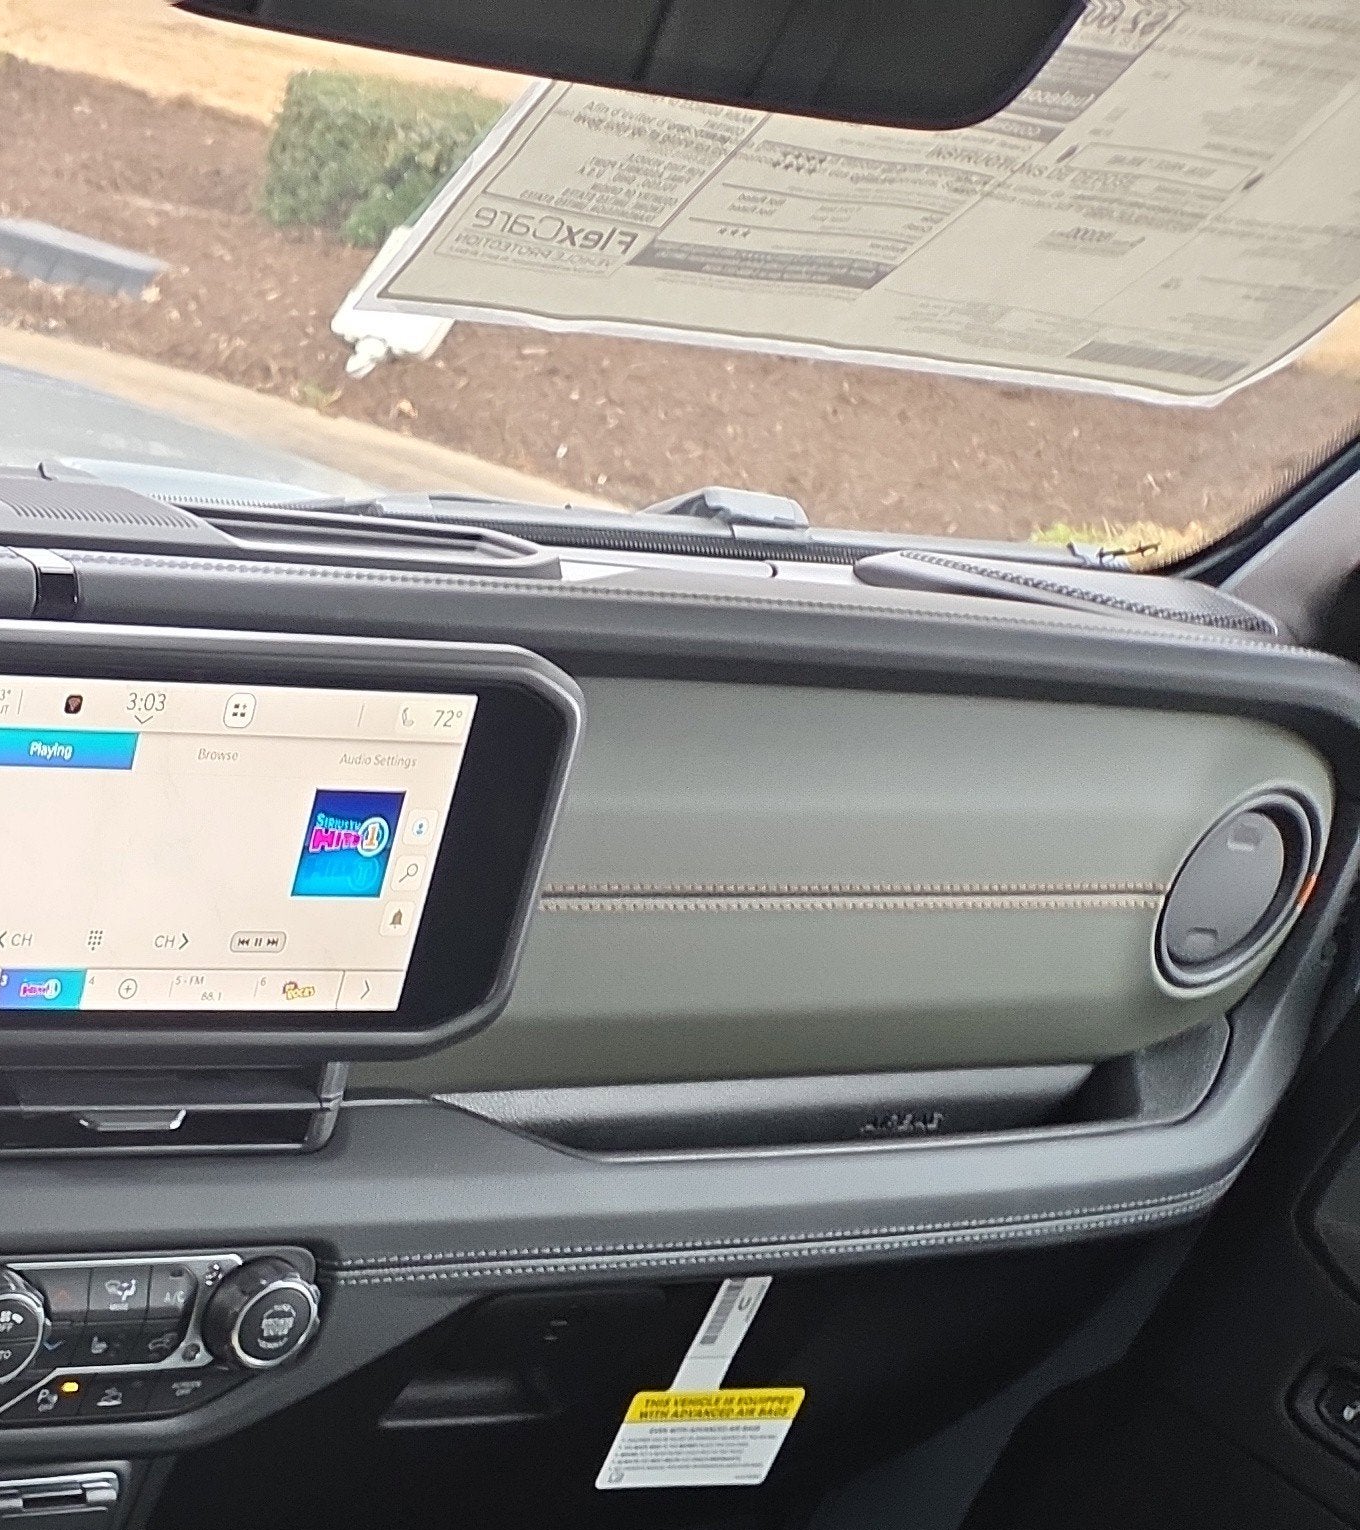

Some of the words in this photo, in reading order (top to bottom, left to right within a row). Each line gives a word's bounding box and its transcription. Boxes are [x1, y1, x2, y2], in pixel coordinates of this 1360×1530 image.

[126, 693, 167, 713] 3:03
[432, 709, 463, 728] 72°
[30, 741, 73, 759] Playing
[197, 749, 239, 763] Browse
[339, 753, 371, 767] Audio
[373, 754, 417, 769] Settings
[11, 933, 33, 947] CH
[154, 935, 176, 948] CH
